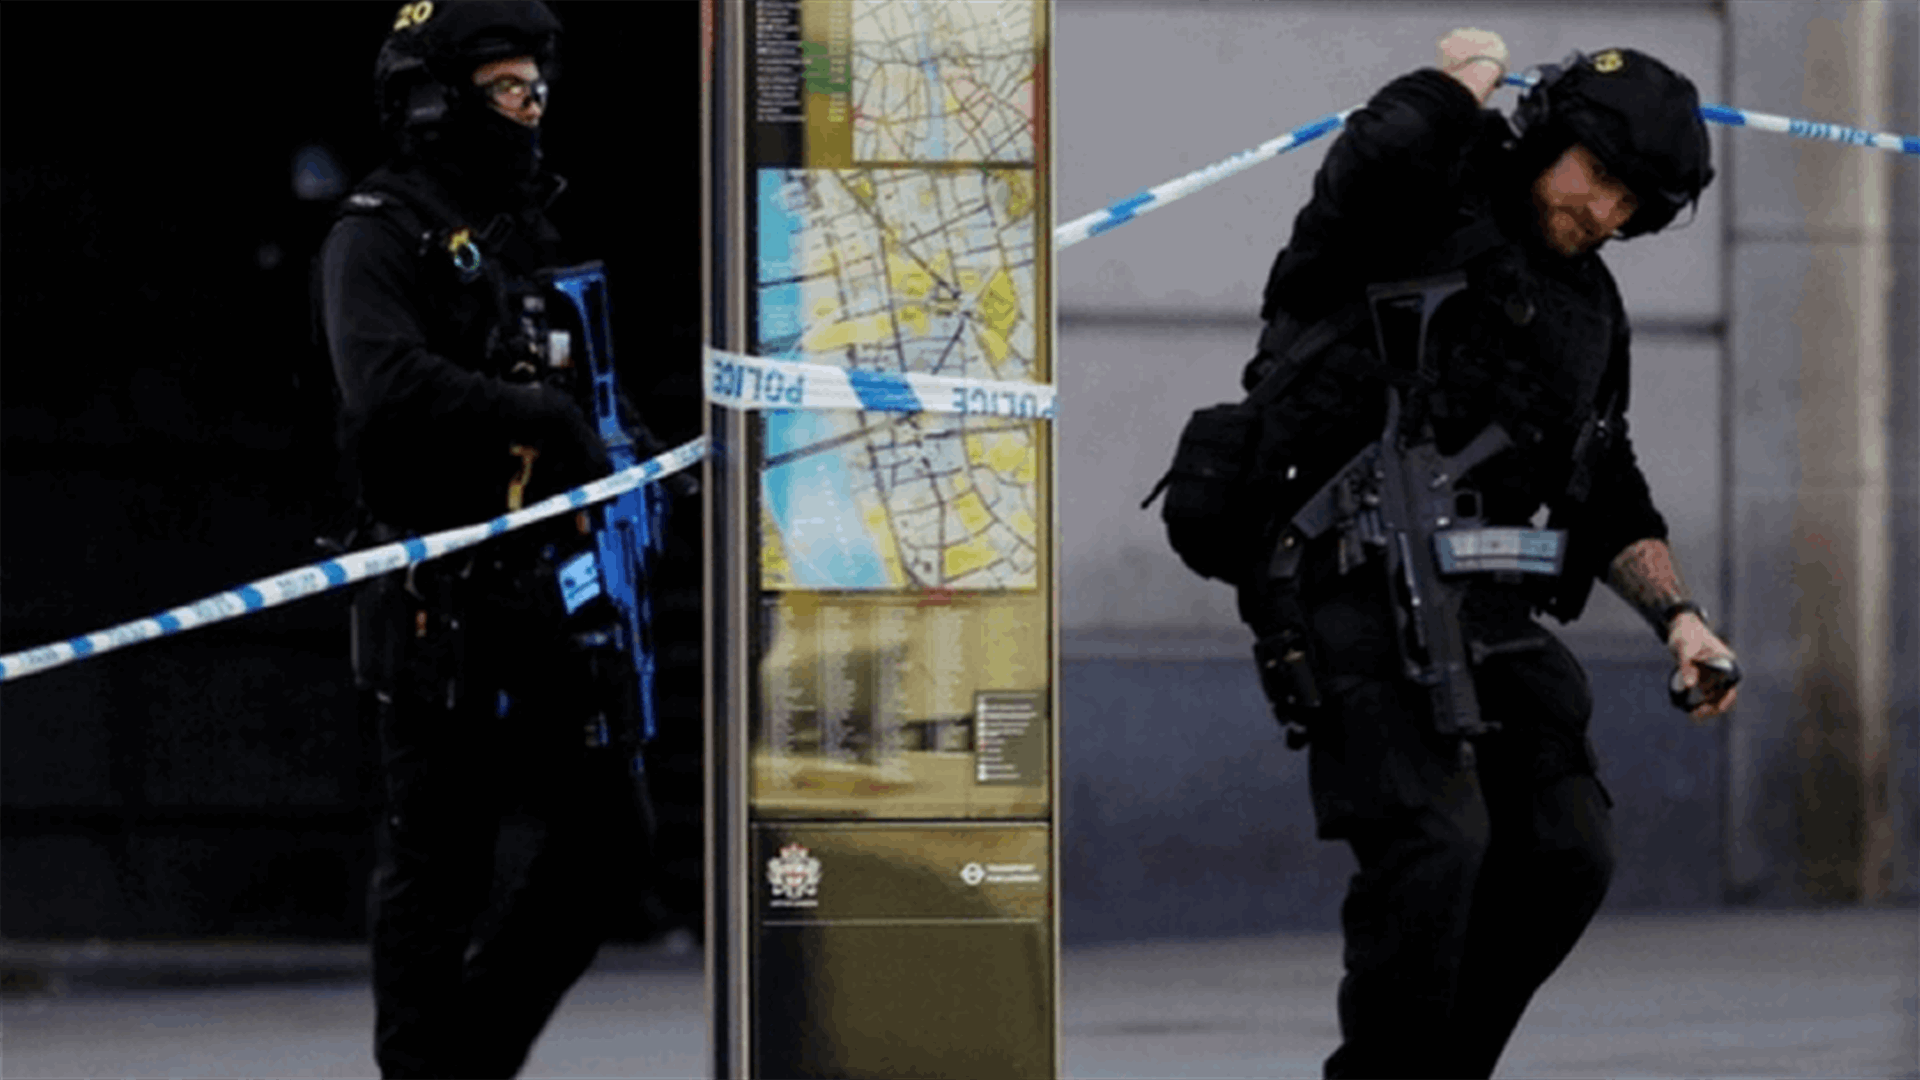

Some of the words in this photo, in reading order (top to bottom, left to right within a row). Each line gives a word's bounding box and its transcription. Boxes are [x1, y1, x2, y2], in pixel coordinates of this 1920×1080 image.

[393, 0, 434, 30] 20
[713, 359, 805, 404] POLICE
[951, 387, 1060, 419] POLICE
